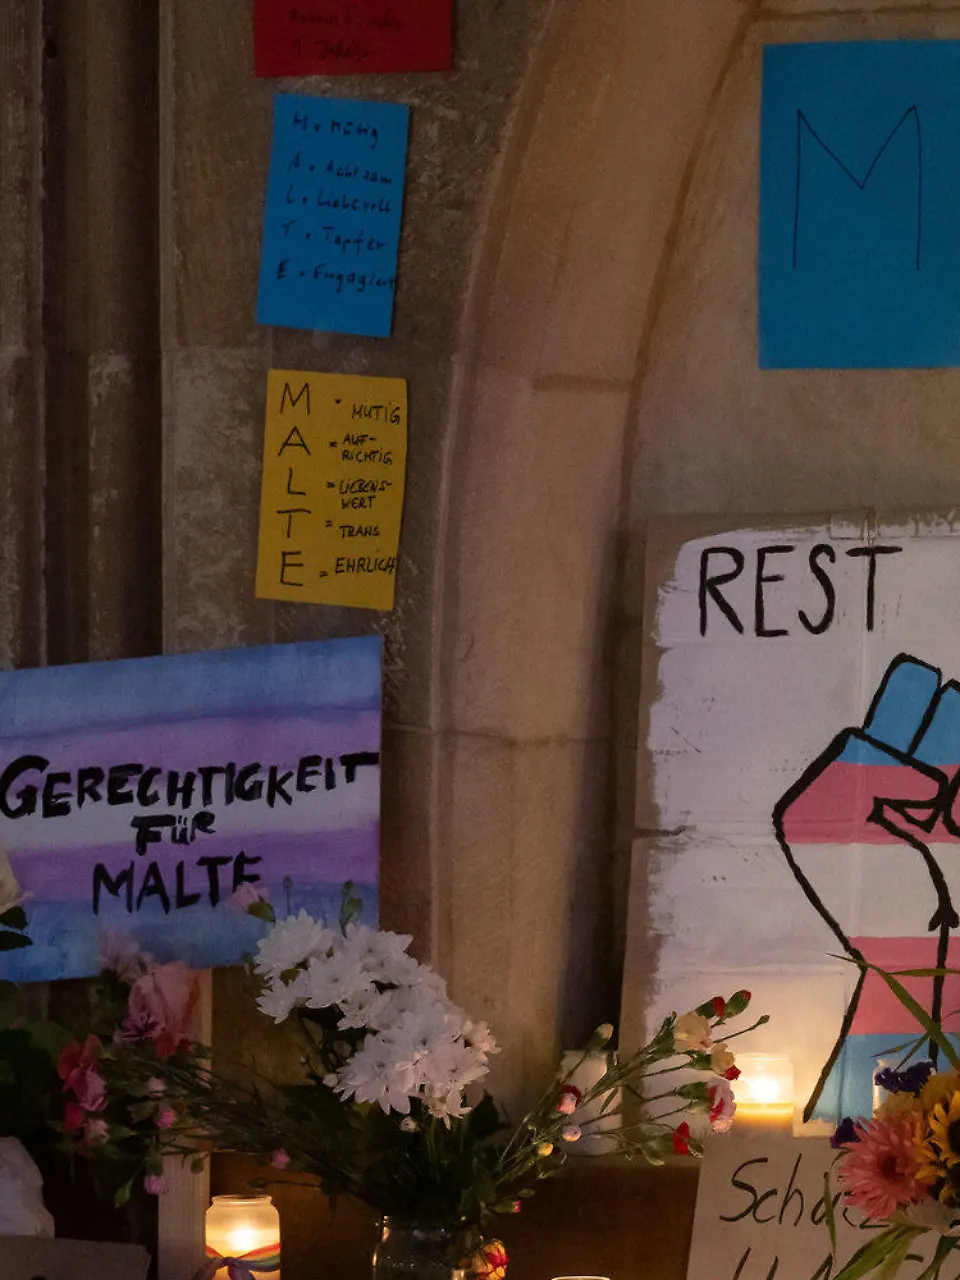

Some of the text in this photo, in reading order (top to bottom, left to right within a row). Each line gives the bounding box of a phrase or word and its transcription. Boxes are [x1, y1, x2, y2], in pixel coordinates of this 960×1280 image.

[793, 105, 923, 271] M
[699, 543, 902, 637] REST
[1, 752, 380, 820] GERECHTIGKEIT
